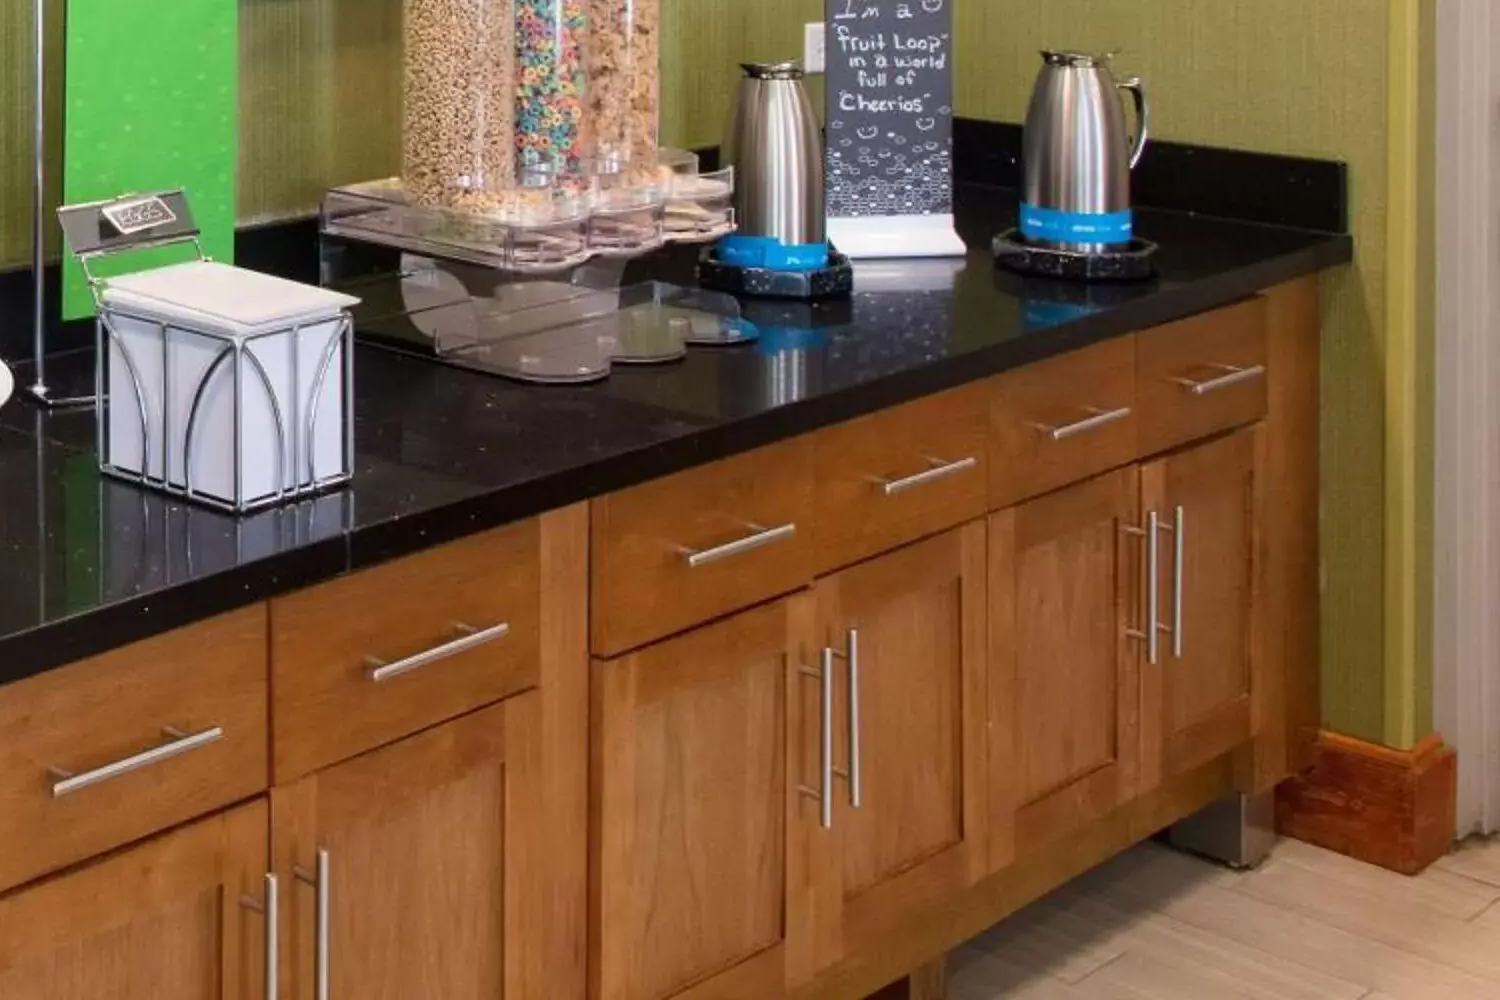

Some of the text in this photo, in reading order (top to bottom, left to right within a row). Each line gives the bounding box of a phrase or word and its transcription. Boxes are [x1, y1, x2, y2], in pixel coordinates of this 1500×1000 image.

[897, 3, 913, 19] a
[849, 52, 946, 70] in a world
[857, 69, 916, 87] full of
